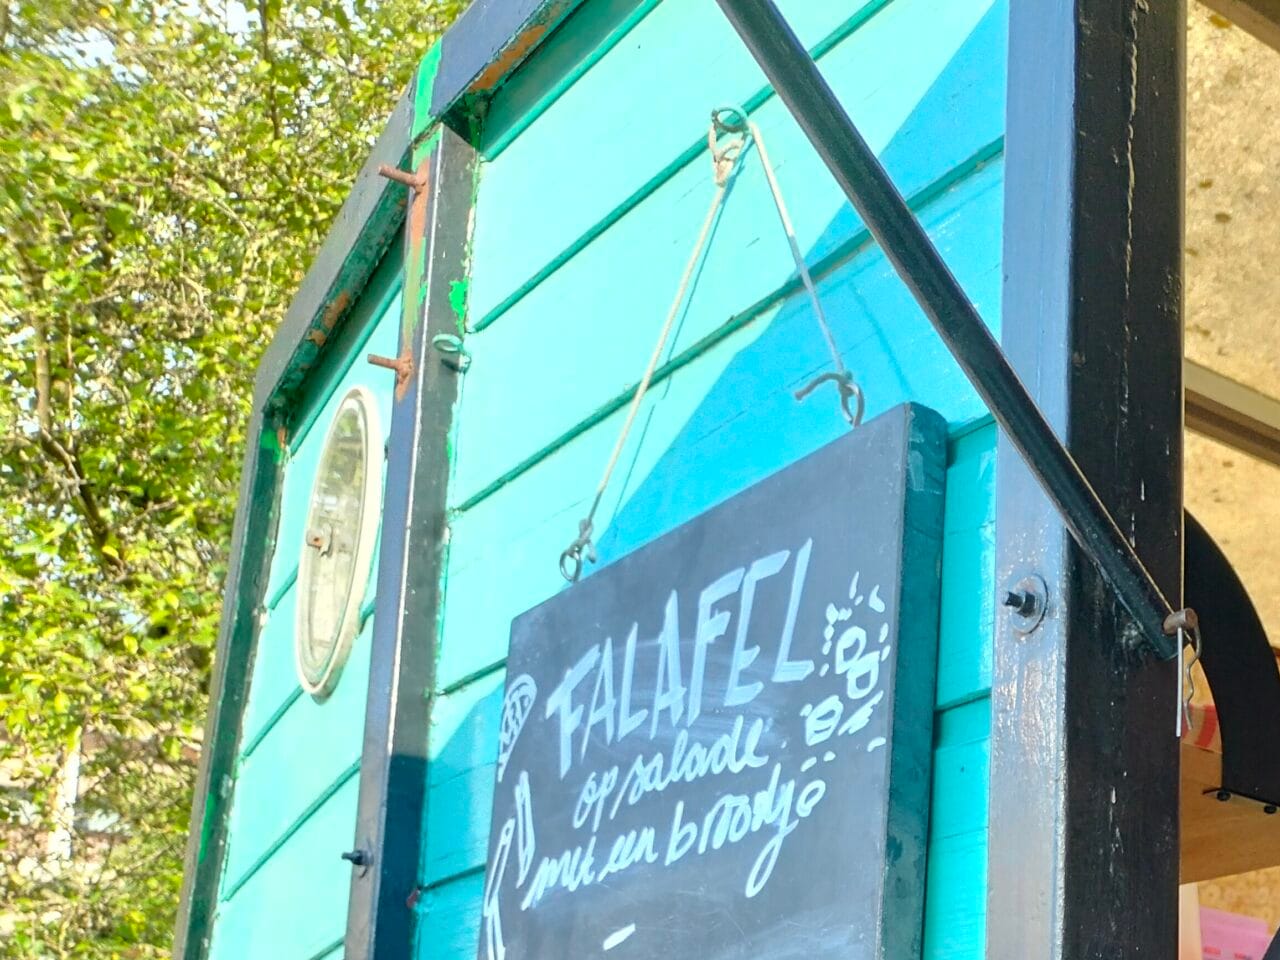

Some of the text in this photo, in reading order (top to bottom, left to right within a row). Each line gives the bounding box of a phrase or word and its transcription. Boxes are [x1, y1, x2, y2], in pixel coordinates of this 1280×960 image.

[545, 538, 814, 780] FALAFEL
[573, 716, 769, 832] op salade
[521, 835, 597, 911] met
[597, 826, 659, 882] een
